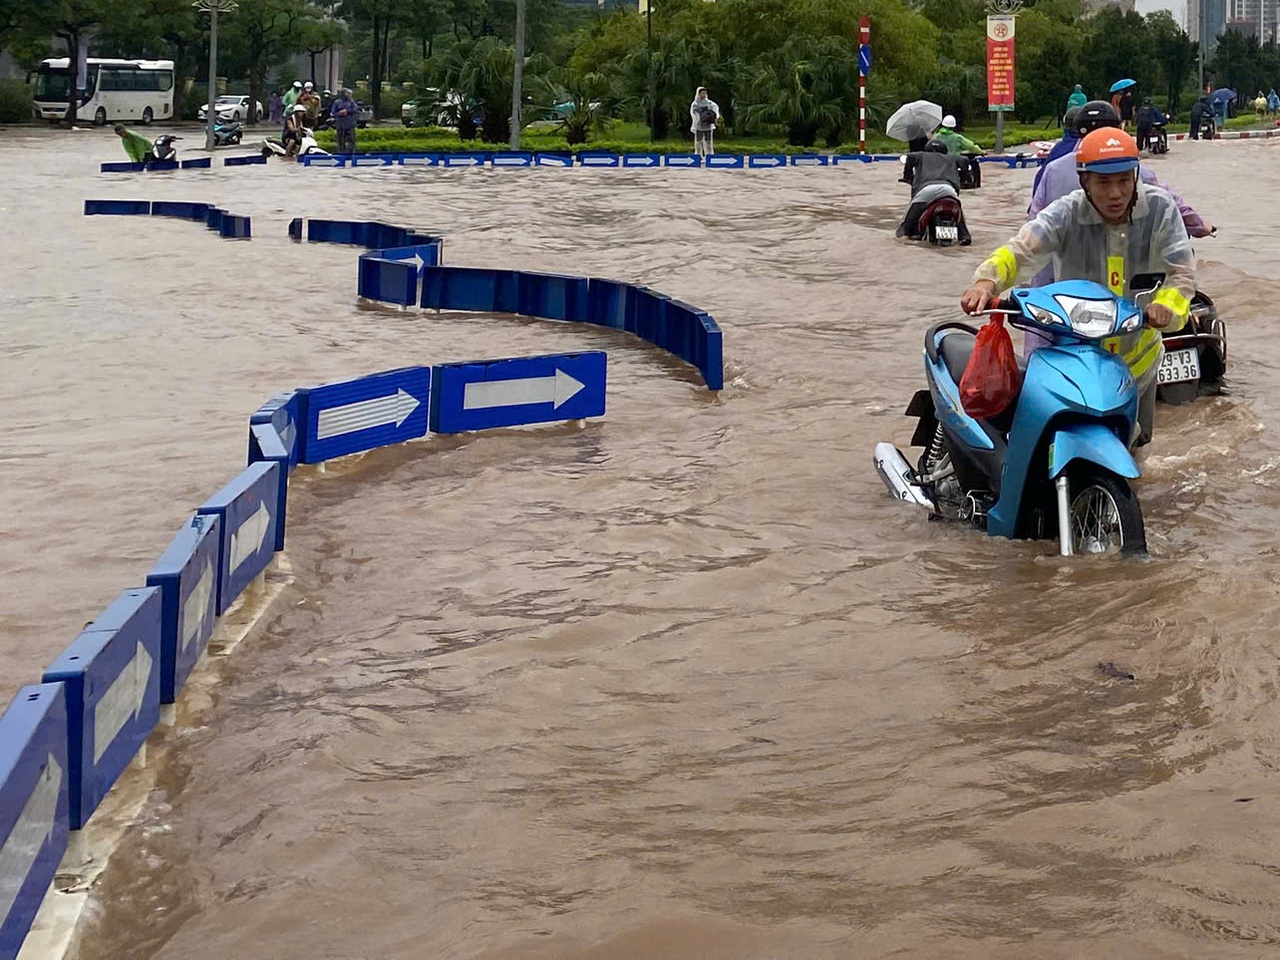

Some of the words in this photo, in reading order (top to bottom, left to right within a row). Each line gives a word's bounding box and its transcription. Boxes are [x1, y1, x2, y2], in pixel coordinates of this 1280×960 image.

[1111, 272, 1119, 286] C
[1161, 351, 1191, 367] 29-V3
[1158, 364, 1197, 382] 633.36
